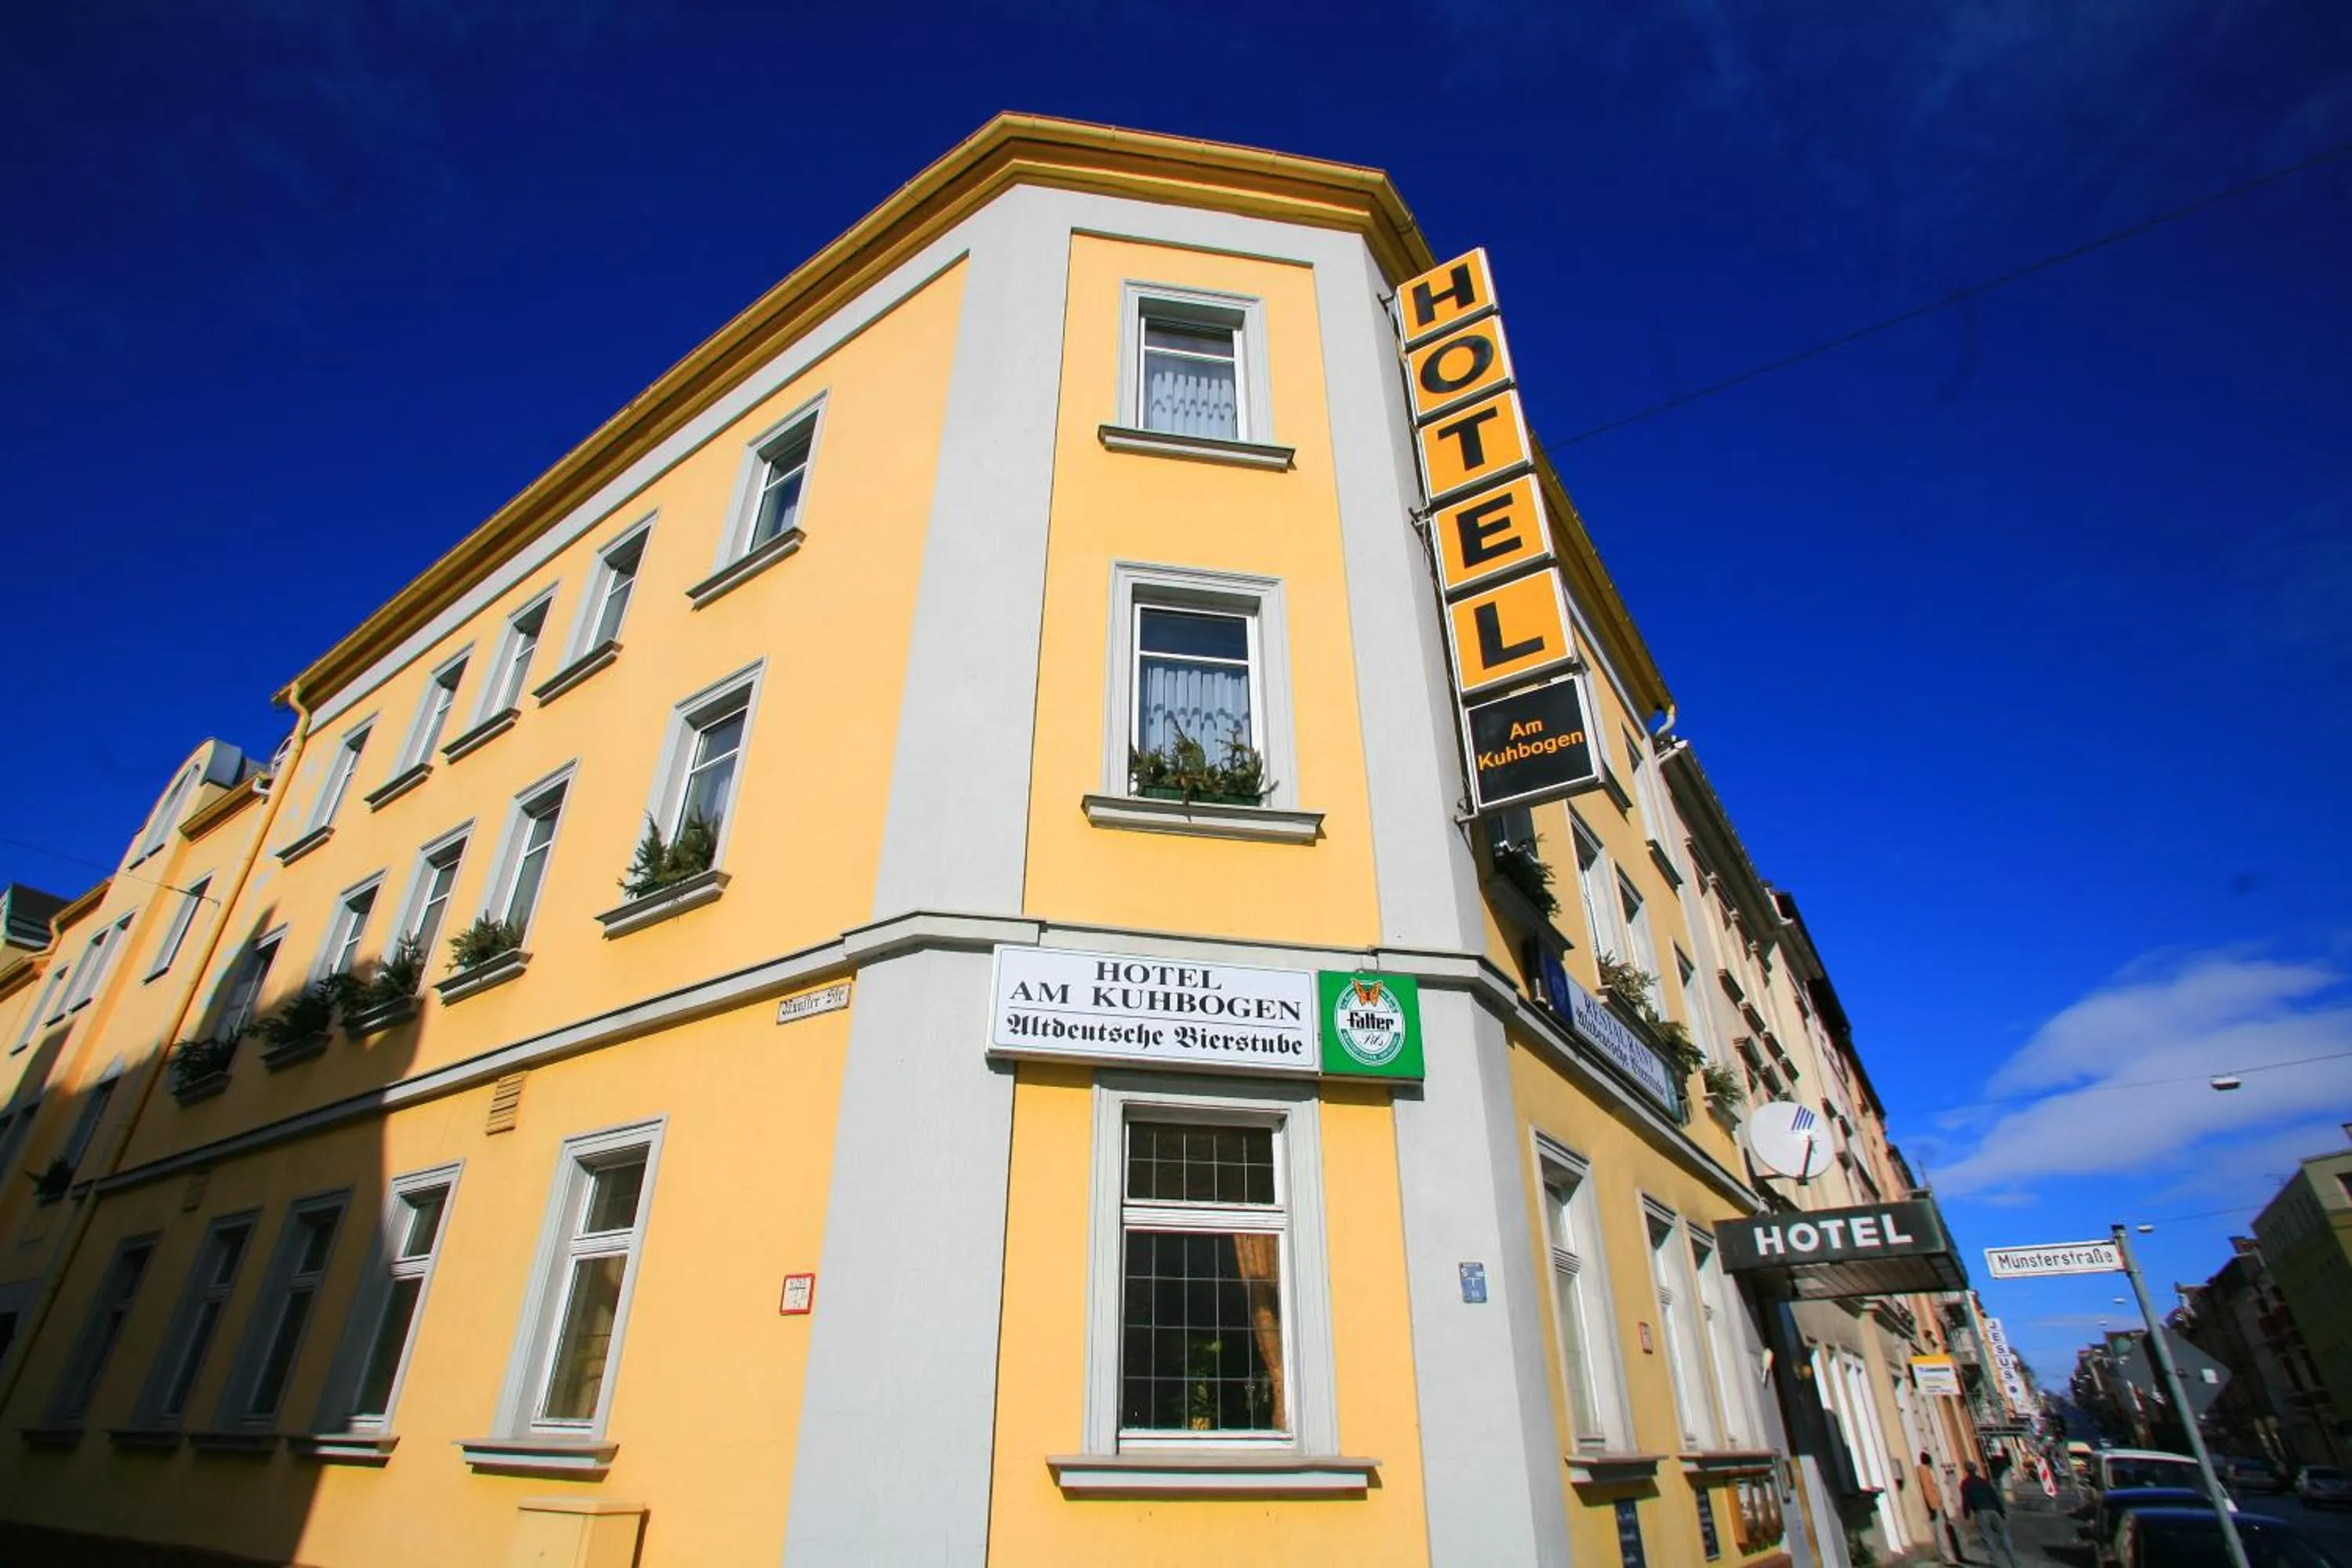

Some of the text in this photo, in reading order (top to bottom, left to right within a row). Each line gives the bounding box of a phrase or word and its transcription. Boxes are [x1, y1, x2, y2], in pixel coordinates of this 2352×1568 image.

[1412, 263, 1545, 670] HOTEL
[1509, 719, 1544, 741] Am
[1478, 731, 1584, 771] Kuhbogen
[1095, 961, 1221, 990] HOTEL
[1009, 981, 1071, 1004] AM
[1091, 985, 1302, 1022] KUHBOGEN
[1007, 1014, 1163, 1049] Altdeutsche
[1174, 1026, 1303, 1054] Bierstube
[1754, 1214, 1914, 1255] HOTEL
[1998, 1247, 2113, 1269] Münsterstraße
[1989, 1321, 2013, 1380] JESUS
